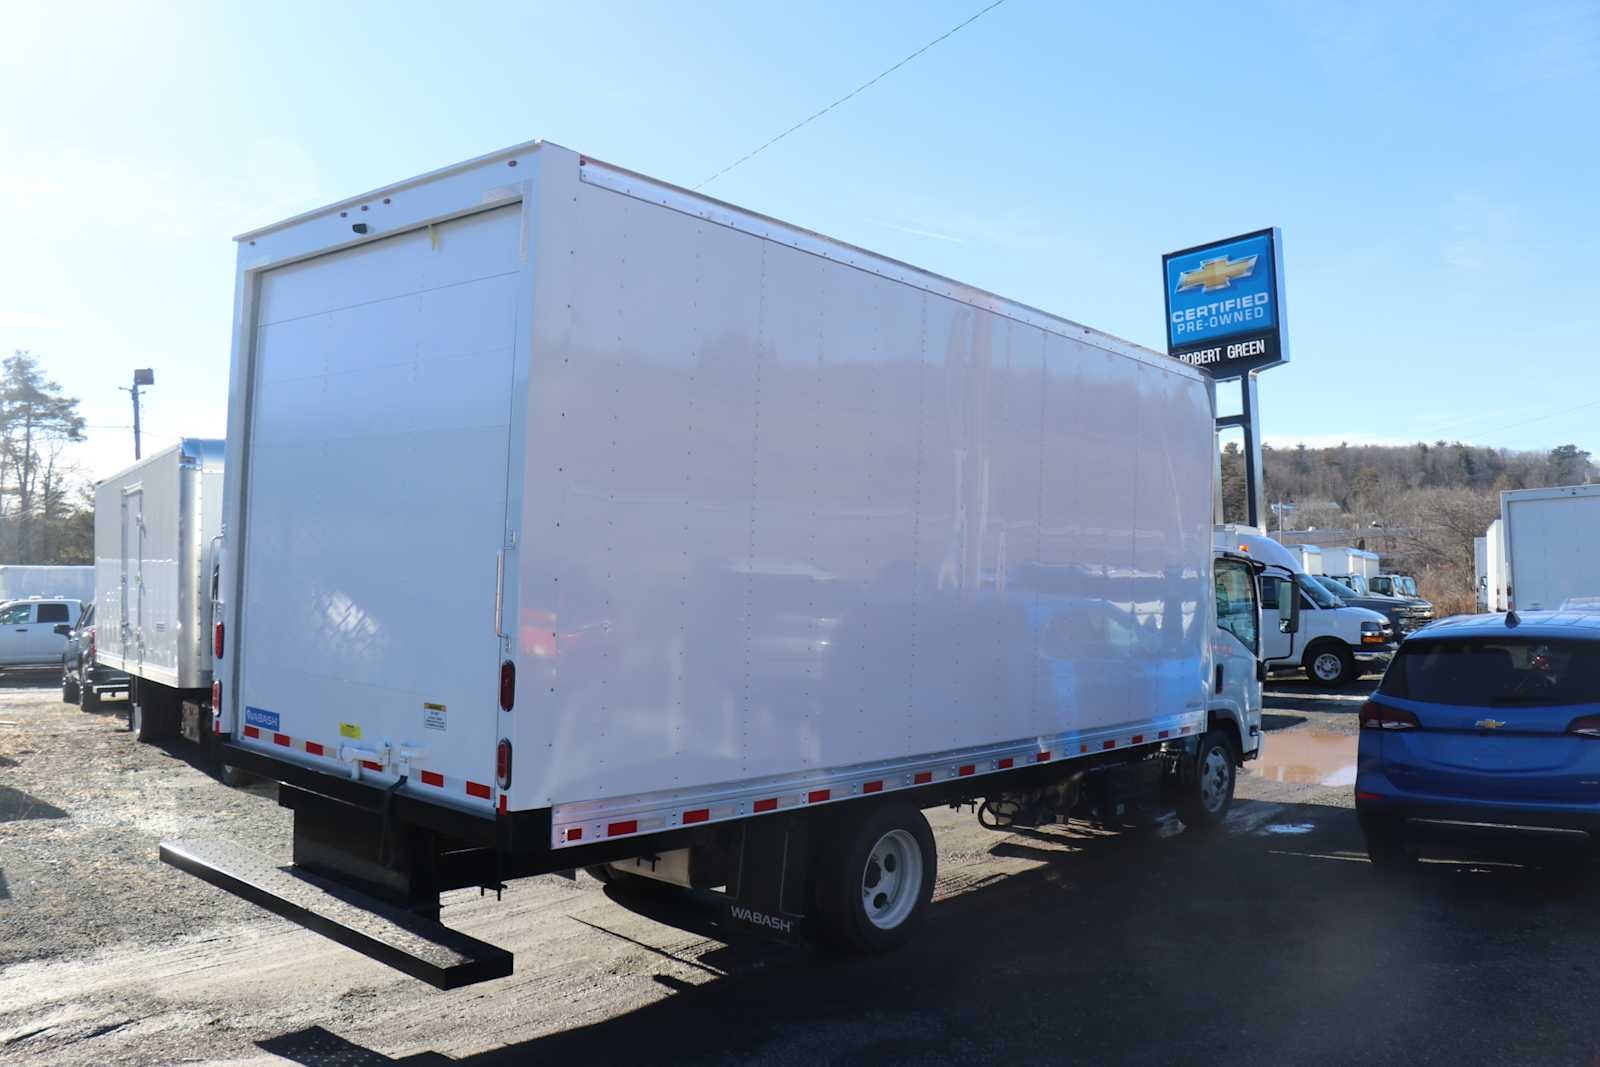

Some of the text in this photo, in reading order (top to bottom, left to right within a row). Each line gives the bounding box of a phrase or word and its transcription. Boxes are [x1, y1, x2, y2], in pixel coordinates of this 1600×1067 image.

[1172, 292, 1269, 323] CERTIFIED
[1177, 306, 1264, 335] PRE-OWNED
[1227, 339, 1265, 359] GREEN
[730, 905, 792, 933] WABASH
